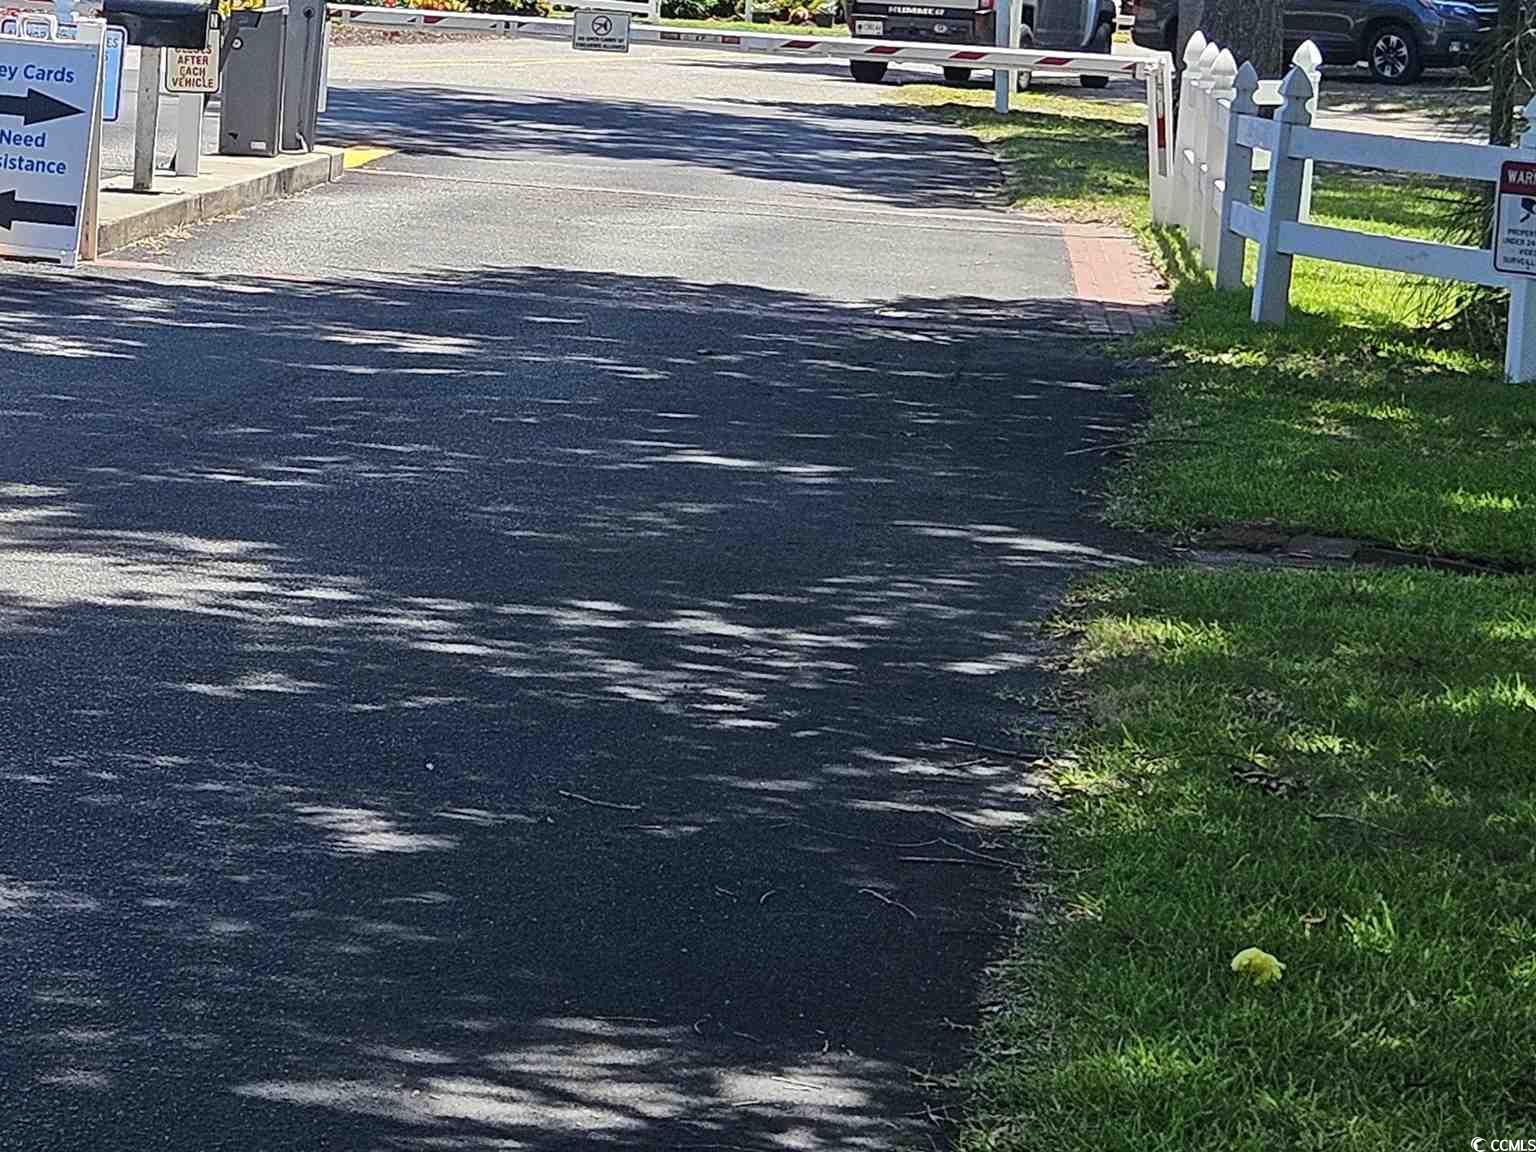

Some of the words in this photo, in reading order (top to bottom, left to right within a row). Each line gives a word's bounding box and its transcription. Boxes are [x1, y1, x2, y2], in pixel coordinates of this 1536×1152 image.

[177, 55, 209, 65] AFTER
[23, 64, 75, 83] Cards
[179, 66, 206, 76] EACH
[171, 77, 215, 88] VEHICLE
[0, 129, 46, 148] Need
